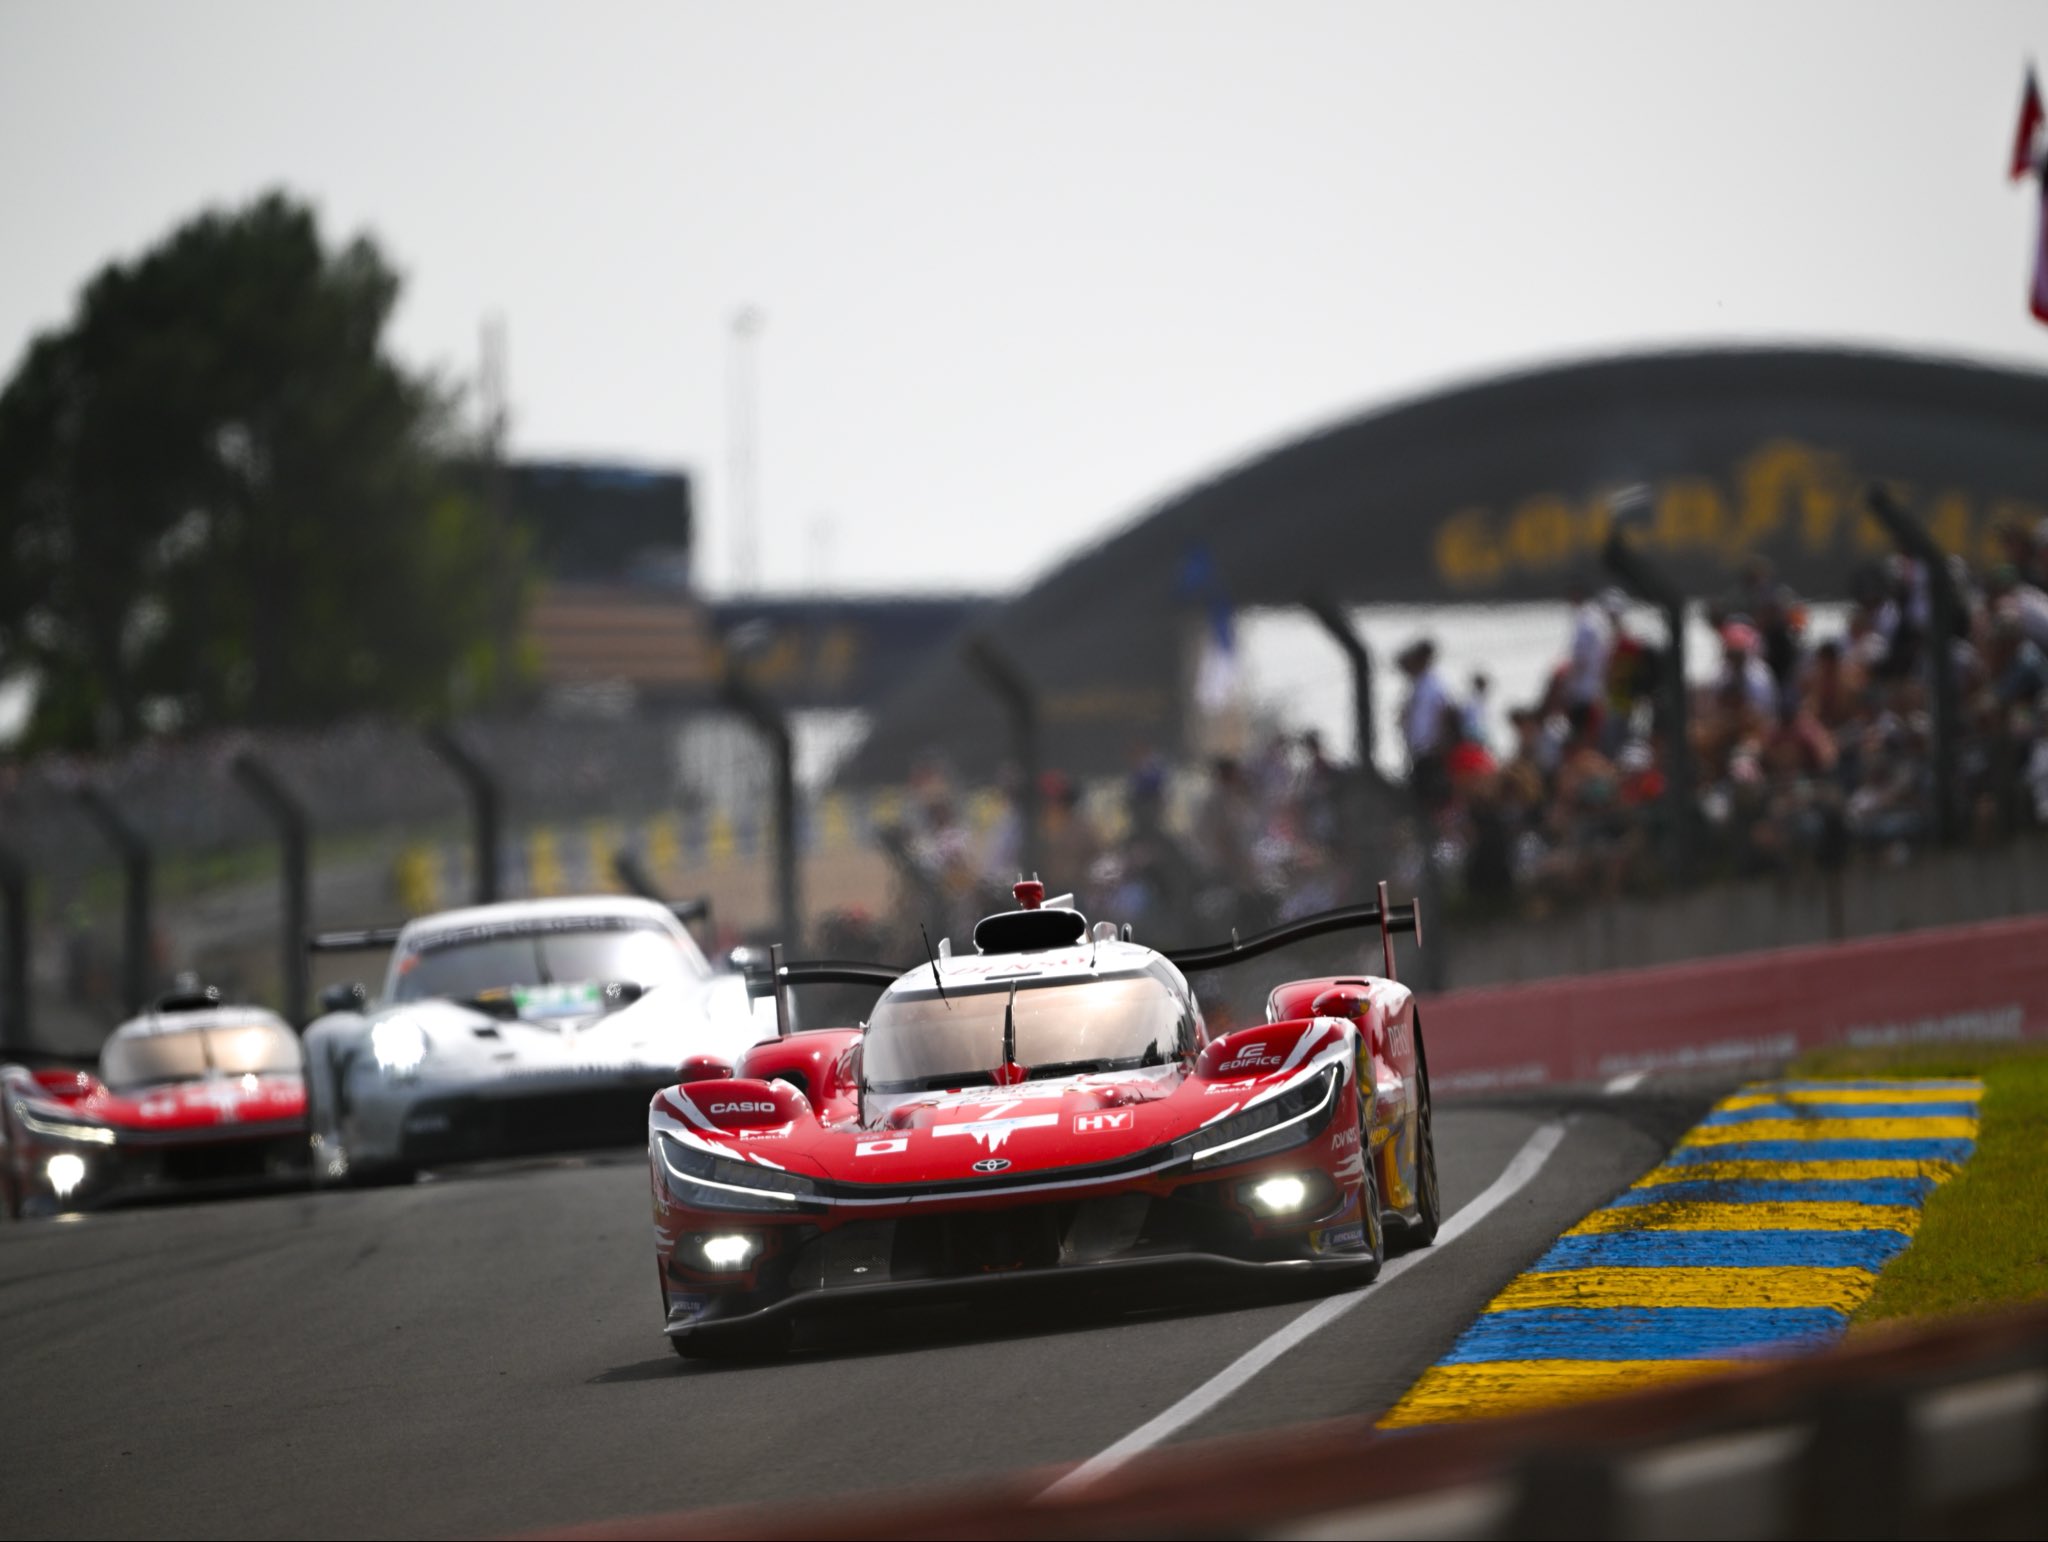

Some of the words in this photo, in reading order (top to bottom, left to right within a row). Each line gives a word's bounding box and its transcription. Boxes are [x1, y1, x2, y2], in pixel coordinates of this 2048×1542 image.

[1218, 1056, 1281, 1071] EDIFICE
[710, 1102, 776, 1114] CASIO
[1078, 1112, 1128, 1131] HY
